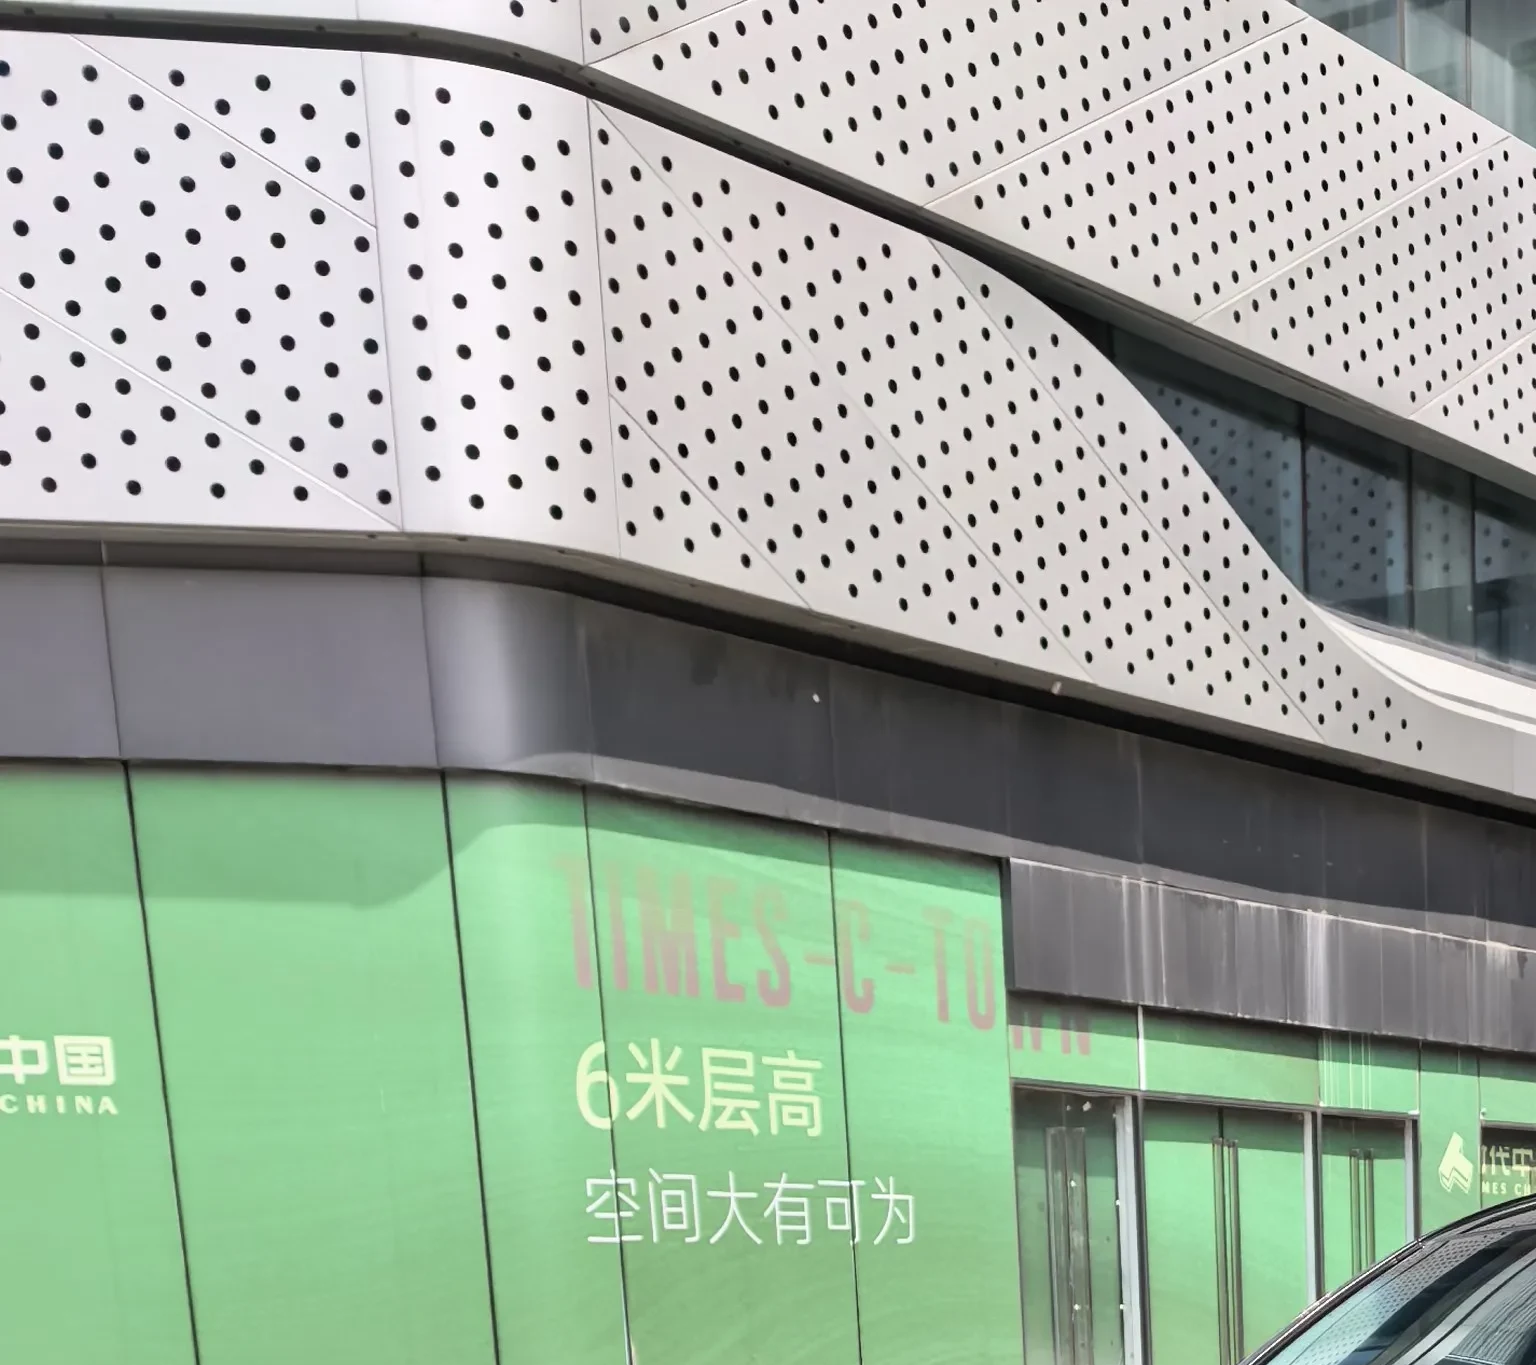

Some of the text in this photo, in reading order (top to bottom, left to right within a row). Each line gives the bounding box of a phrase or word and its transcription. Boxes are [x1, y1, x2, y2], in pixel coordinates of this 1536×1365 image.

[0, 1035, 116, 1086] 中国
[577, 1038, 823, 1136] 6米层高
[0, 1094, 118, 1115] CHINA
[586, 1167, 915, 1245] 空间大有可为
